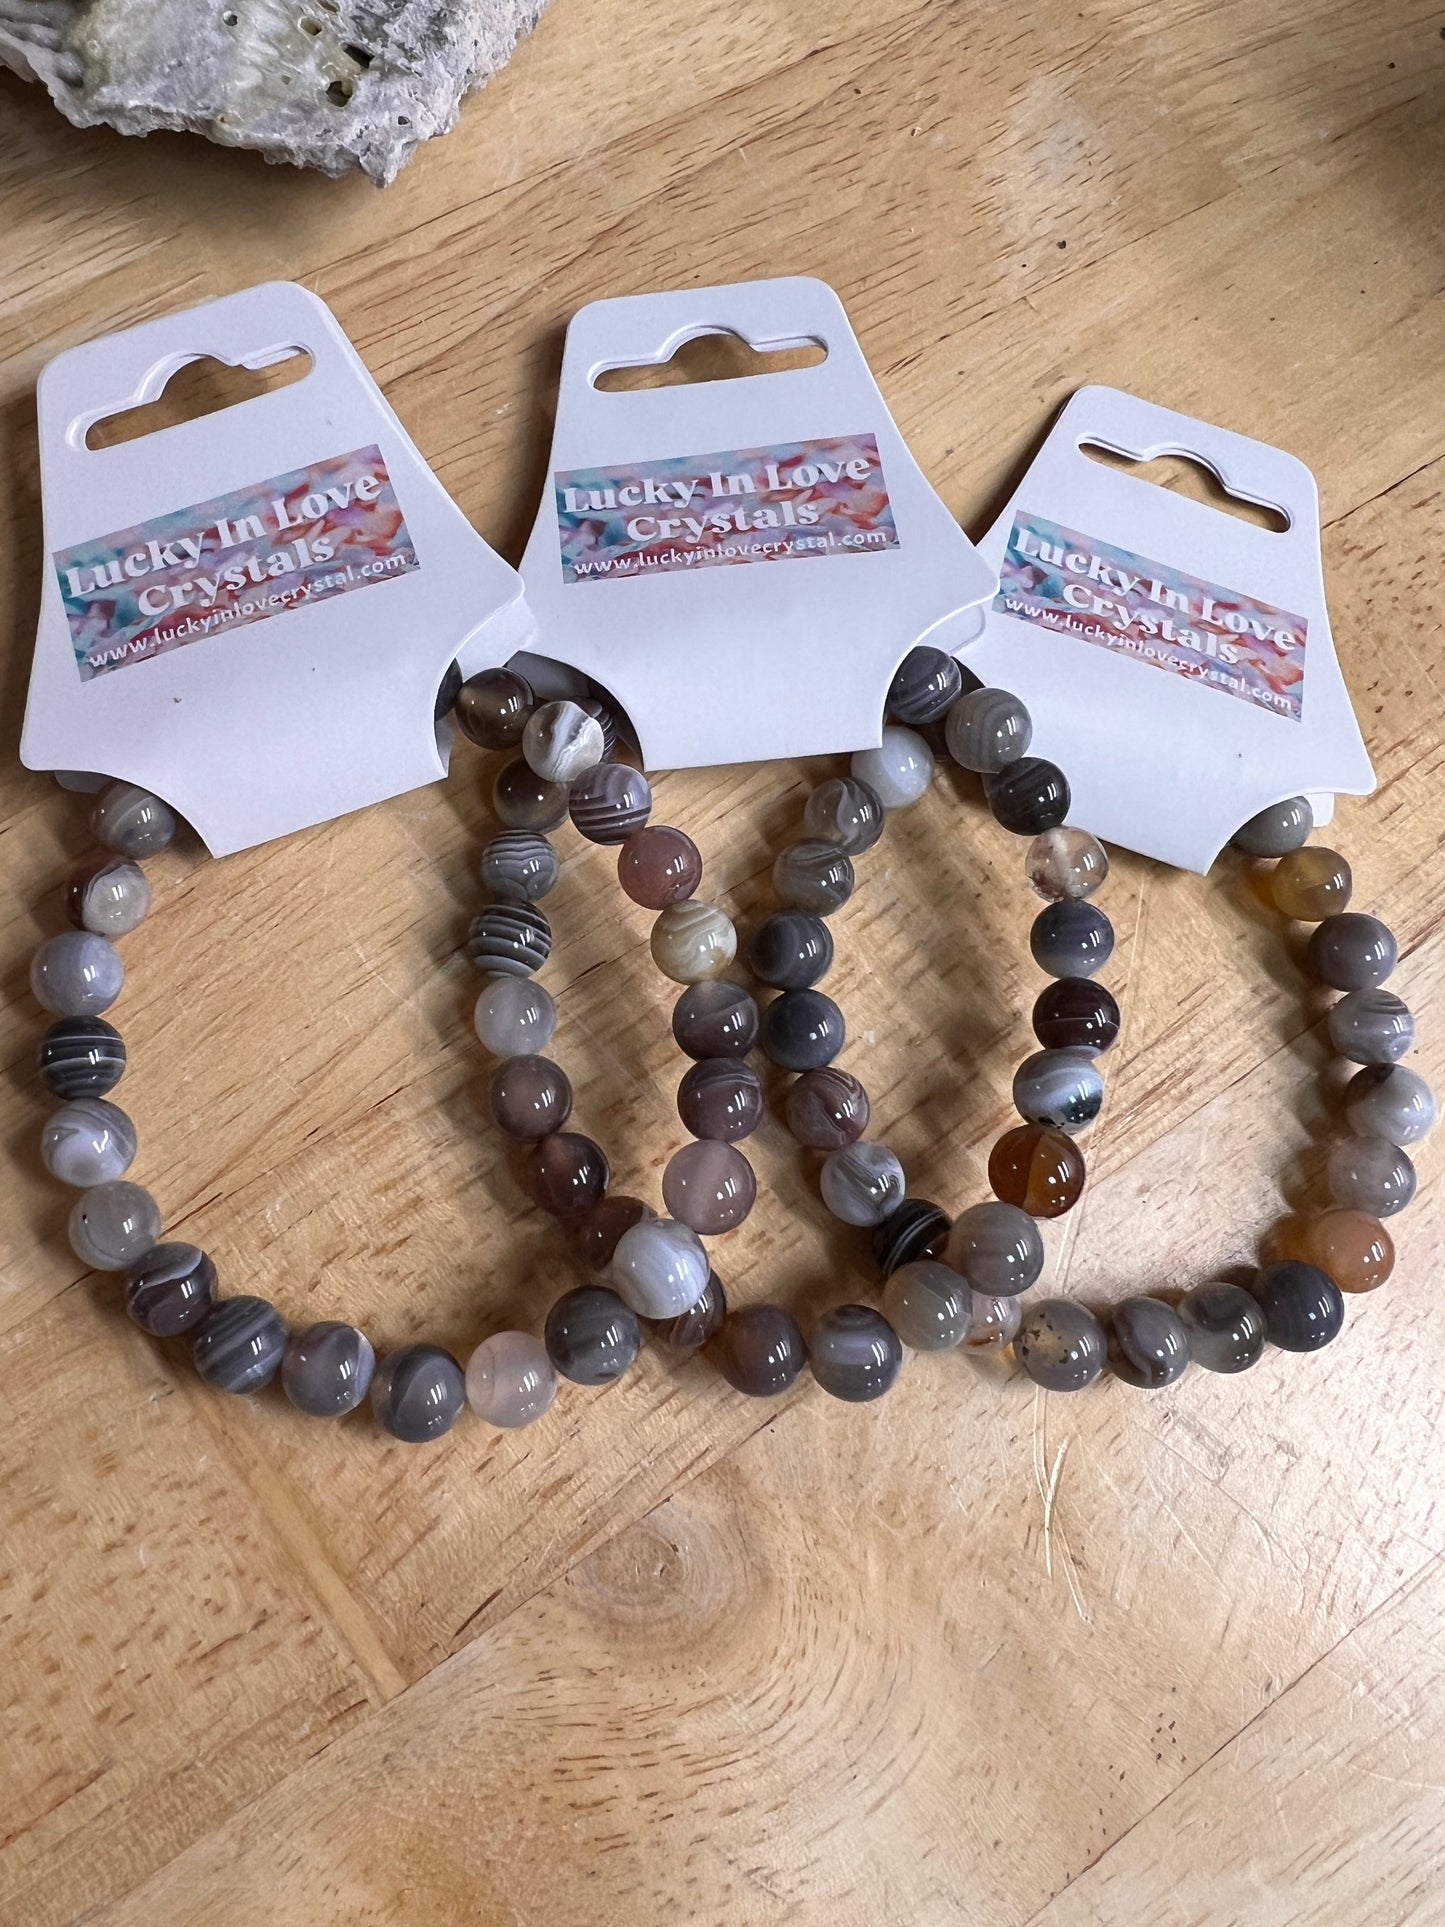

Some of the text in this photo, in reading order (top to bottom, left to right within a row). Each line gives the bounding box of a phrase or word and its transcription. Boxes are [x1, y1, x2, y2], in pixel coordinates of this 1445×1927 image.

[564, 457, 871, 513] Lucky In Love
[626, 500, 819, 543] Crystals
[65, 474, 384, 598] Lucky In Love
[137, 534, 336, 616] Crystals
[574, 530, 887, 575] www.luckyinlovecrystal.com
[88, 552, 407, 668] www.luckyinlovecrystal.com
[1013, 528, 1296, 651] Lucky In Love
[1063, 583, 1241, 665] Crystals
[1005, 597, 1292, 710] www.luckyinlovecrystal.com
